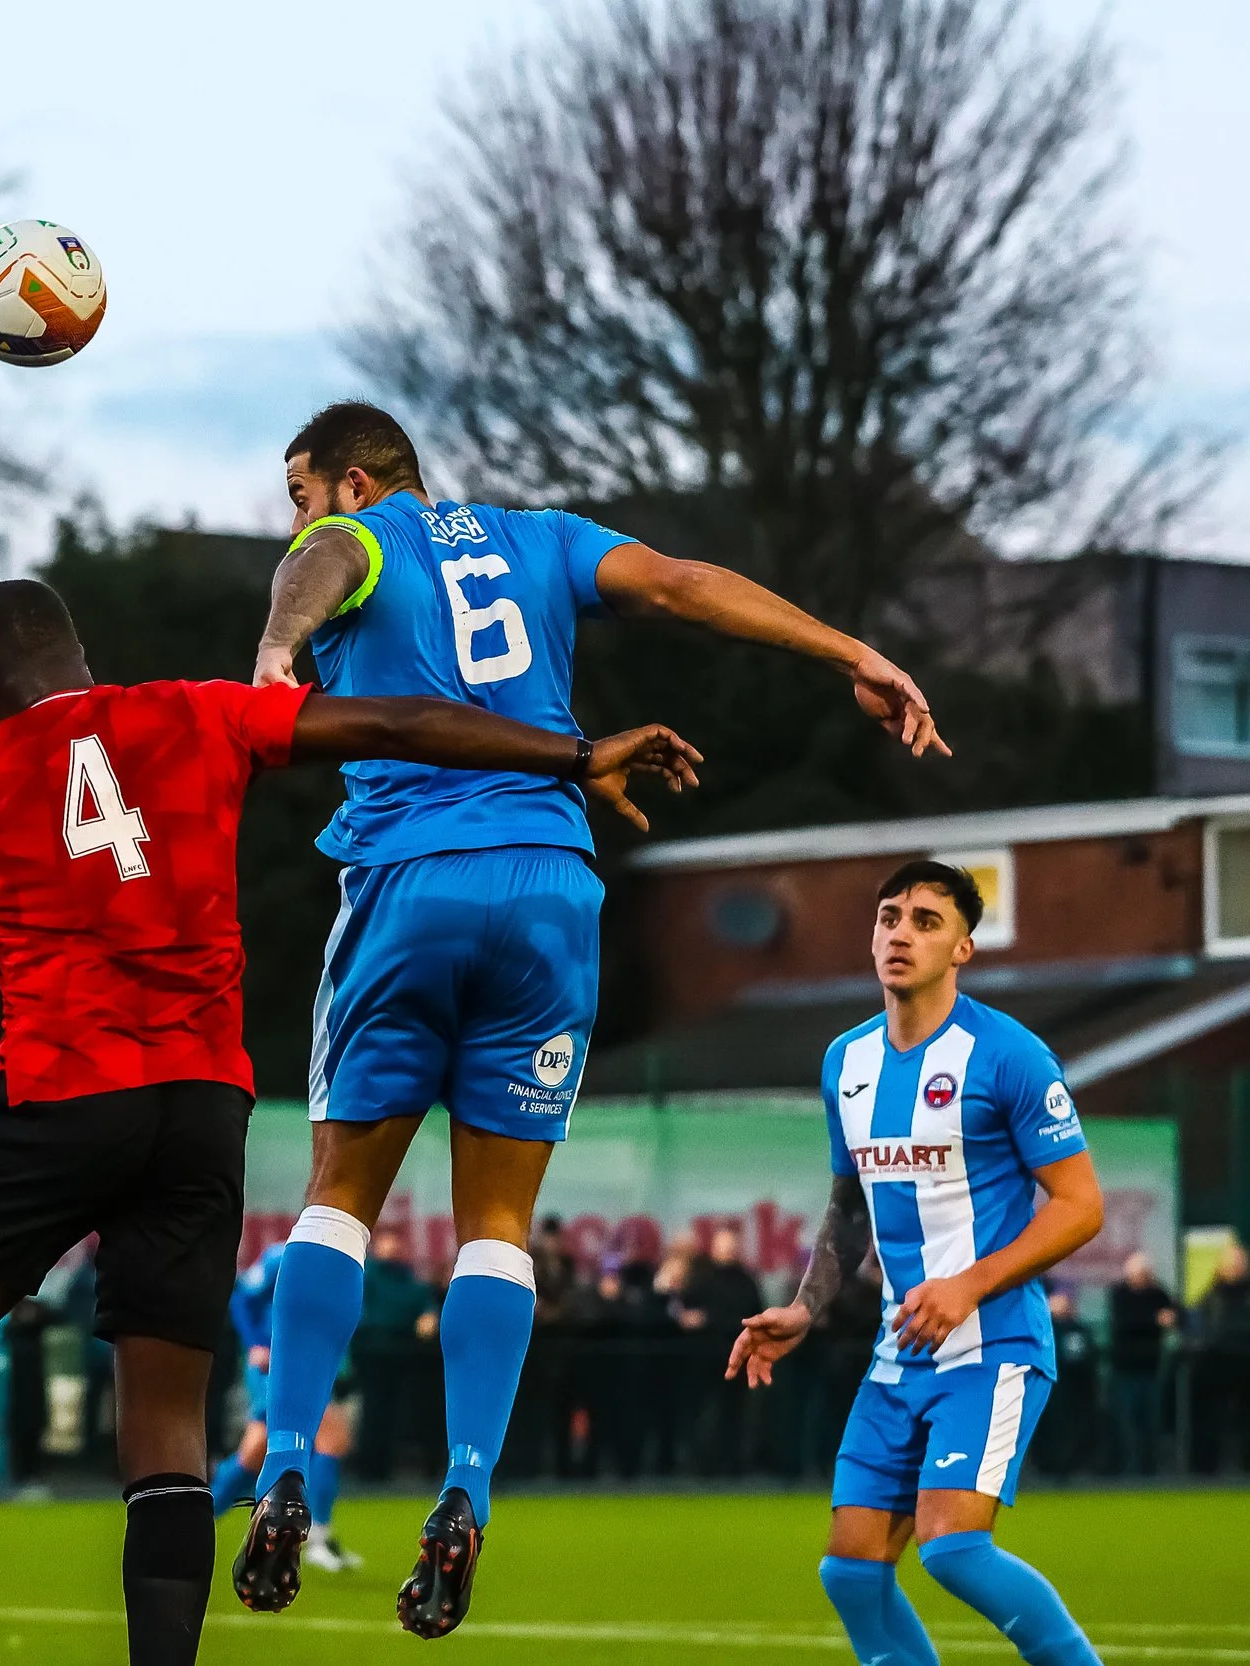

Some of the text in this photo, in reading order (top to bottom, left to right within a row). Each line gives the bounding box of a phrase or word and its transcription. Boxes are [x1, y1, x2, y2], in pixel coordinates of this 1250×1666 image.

[440, 554, 533, 685] 6
[62, 733, 151, 882] 4
[123, 864, 143, 873] LNFC
[538, 1050, 570, 1069] DP's
[507, 1083, 552, 1101] FINANCIAL
[519, 1100, 562, 1114] & SERVICES
